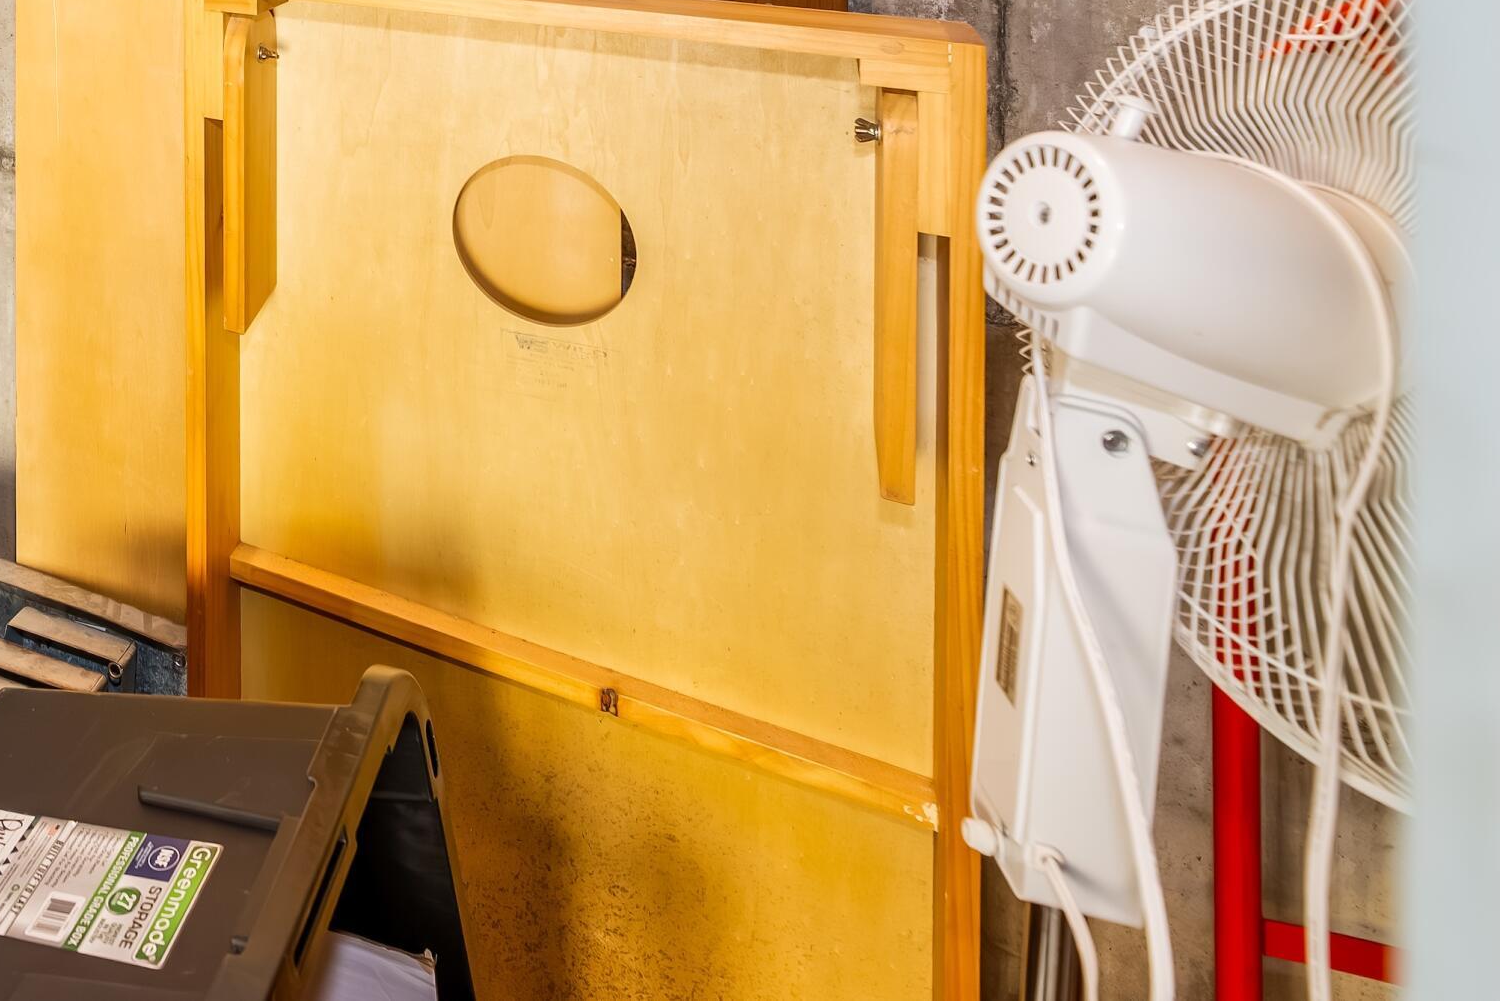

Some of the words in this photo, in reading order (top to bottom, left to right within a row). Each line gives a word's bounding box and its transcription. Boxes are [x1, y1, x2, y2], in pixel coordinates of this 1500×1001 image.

[100, 835, 140, 895] PROFESSIONAL
[155, 849, 174, 868] NSF
[83, 896, 105, 925] GRADE
[117, 892, 137, 911] 27
[142, 847, 211, 956] Greenmade
[119, 885, 162, 949] STORAGE
[67, 925, 86, 947] BOX
